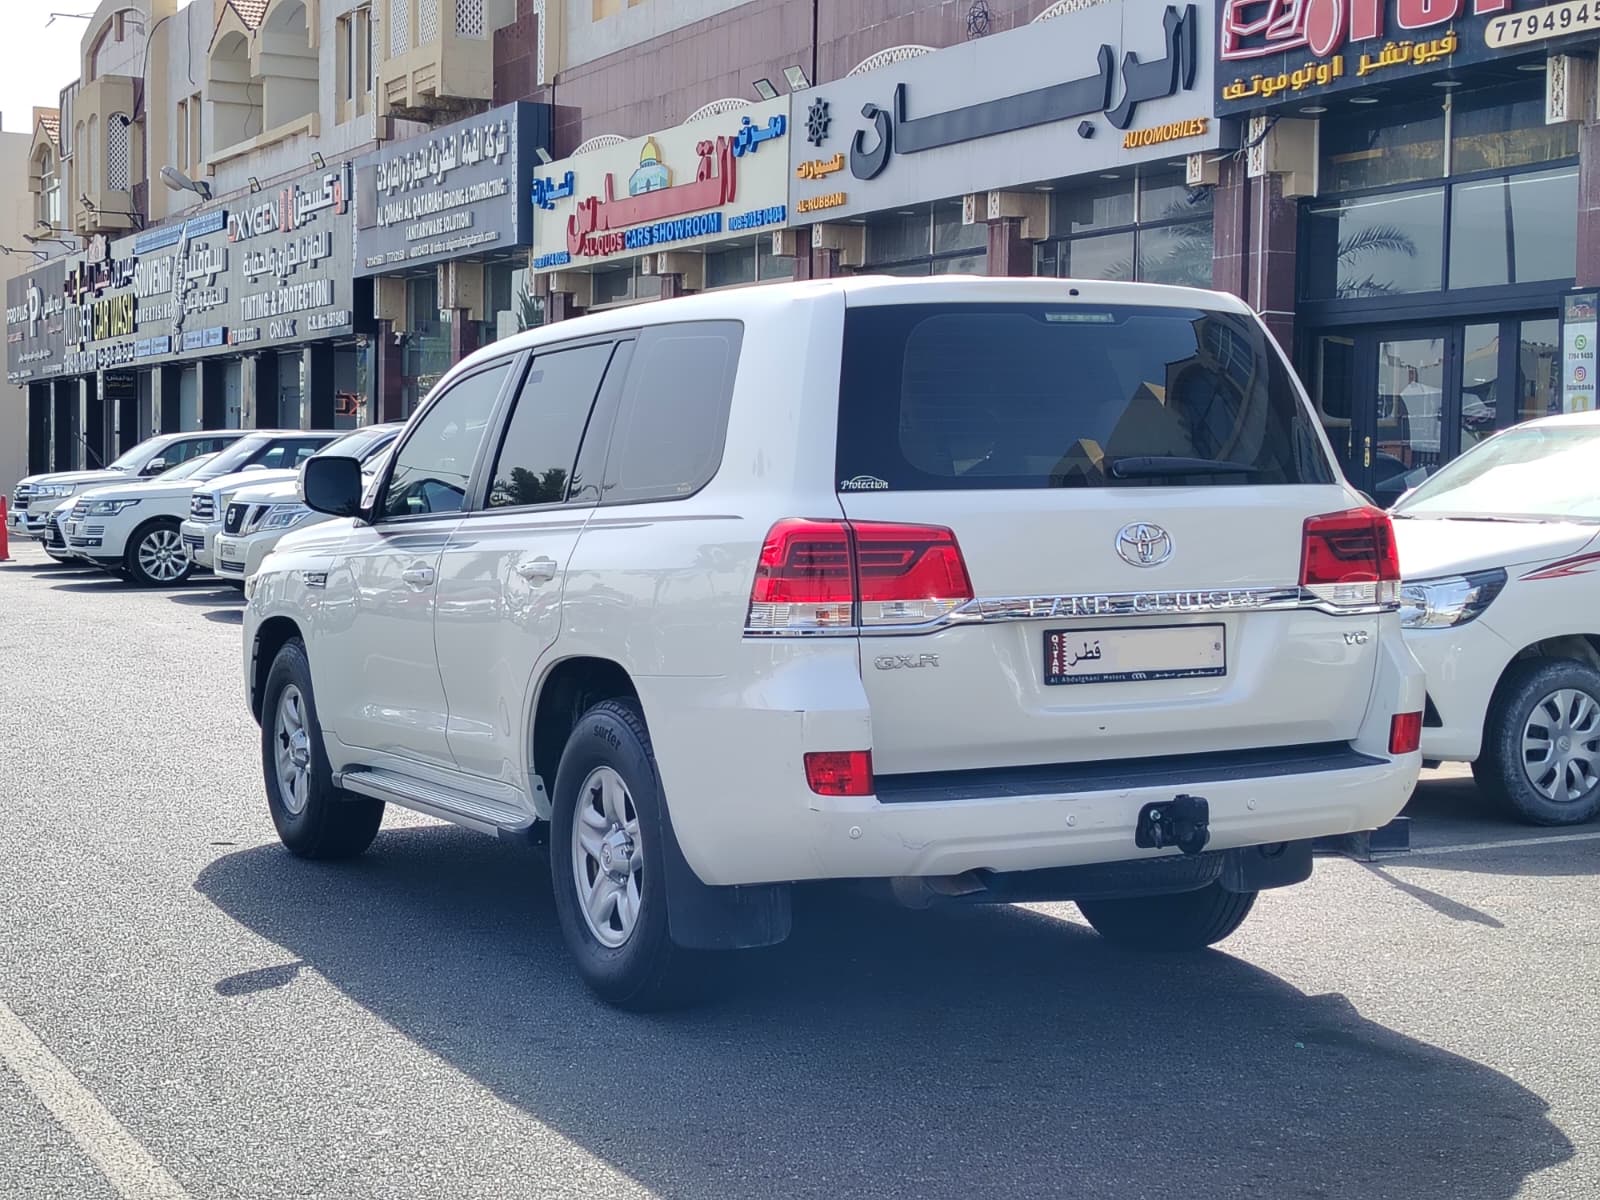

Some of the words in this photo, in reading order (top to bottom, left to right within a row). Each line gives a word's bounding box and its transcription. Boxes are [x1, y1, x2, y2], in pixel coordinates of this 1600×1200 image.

[850, 4, 1196, 180] الربان
[1122, 116, 1208, 149] AUTOMOBILES
[227, 199, 279, 242] OXYGEN
[796, 191, 847, 213] AL-RUBBAN
[625, 226, 651, 249] CARS
[652, 212, 721, 245] SHOWROOM
[93, 299, 109, 341] CAR
[109, 293, 134, 337] WASH
[241, 290, 269, 320] TINTING
[270, 290, 277, 315] &
[278, 278, 329, 314] PROTECTION
[841, 479, 889, 490] Protection
[1050, 634, 1060, 674] QATAR
[1067, 641, 1101, 667] قطر
[1062, 675, 1099, 684] Abdulghani
[1103, 673, 1126, 681] Motors
